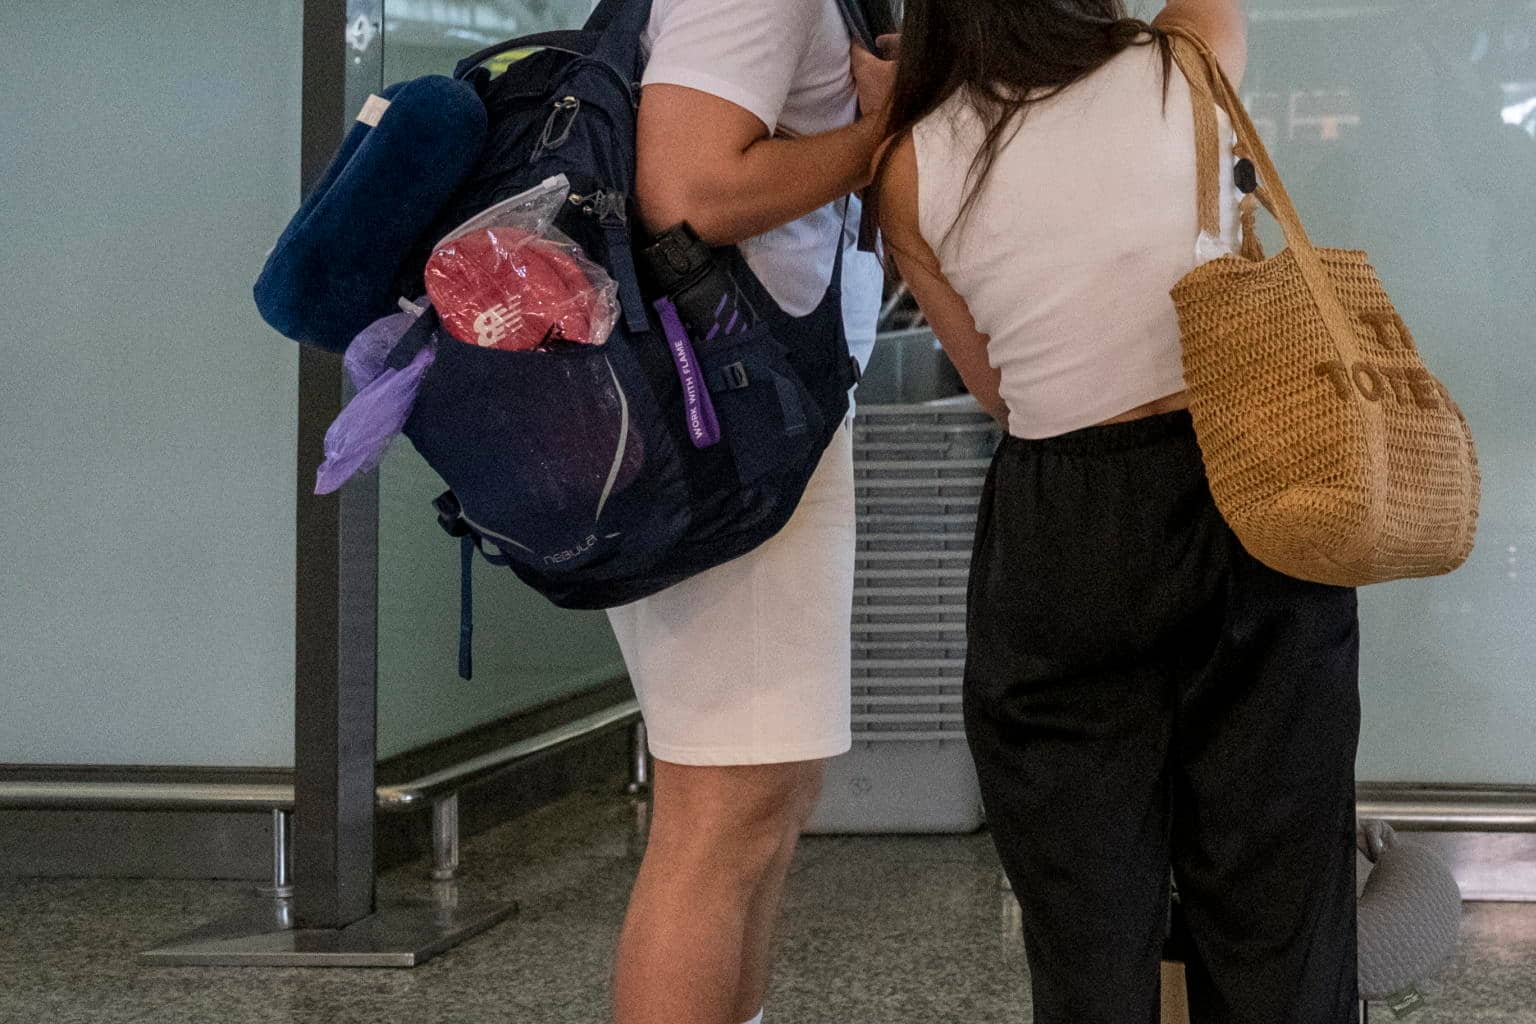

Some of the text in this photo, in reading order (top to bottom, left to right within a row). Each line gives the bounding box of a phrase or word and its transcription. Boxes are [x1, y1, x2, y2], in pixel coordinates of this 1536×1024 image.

[675, 340, 704, 438] WORK WITH FLAME
